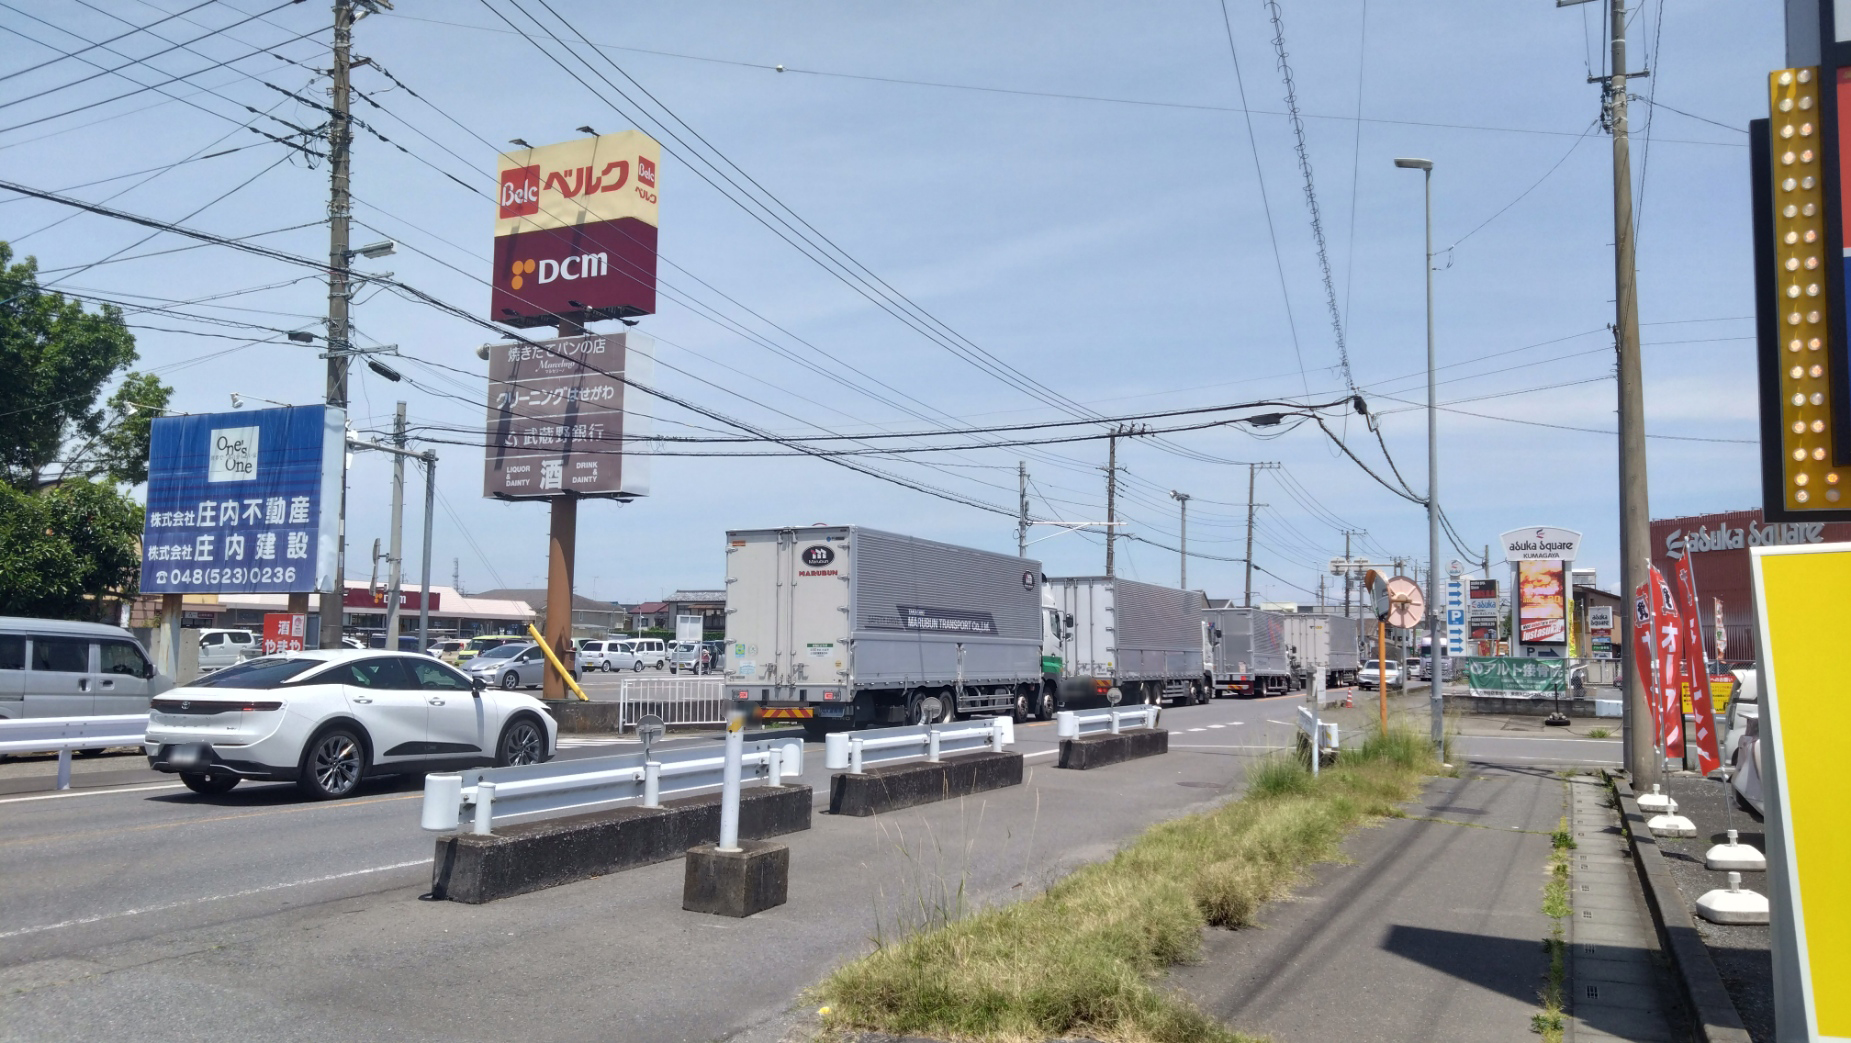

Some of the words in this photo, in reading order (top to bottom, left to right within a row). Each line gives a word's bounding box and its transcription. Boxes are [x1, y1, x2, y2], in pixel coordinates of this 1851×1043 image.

[543, 160, 630, 198] ベルク
[639, 163, 655, 182] Belc
[502, 179, 538, 206] Belc
[635, 186, 657, 204] ベルク
[508, 339, 606, 362] 焼きたてパンの店
[523, 423, 604, 446] 武蔵野銀行
[225, 459, 253, 474] One
[506, 465, 531, 473] LIQUOR
[576, 461, 598, 469] DRINK
[539, 459, 563, 490] 酒
[572, 476, 597, 484] DAINTY
[506, 479, 530, 487] DAINTY
[170, 567, 296, 585] 048(523)0236
[798, 569, 838, 577] MARUBUN
[908, 617, 938, 628] MARUBUN
[939, 618, 972, 630] TRANSPORT
[1451, 611, 1462, 622] P
[278, 620, 290, 635] 酒
[1526, 647, 1535, 657] P
